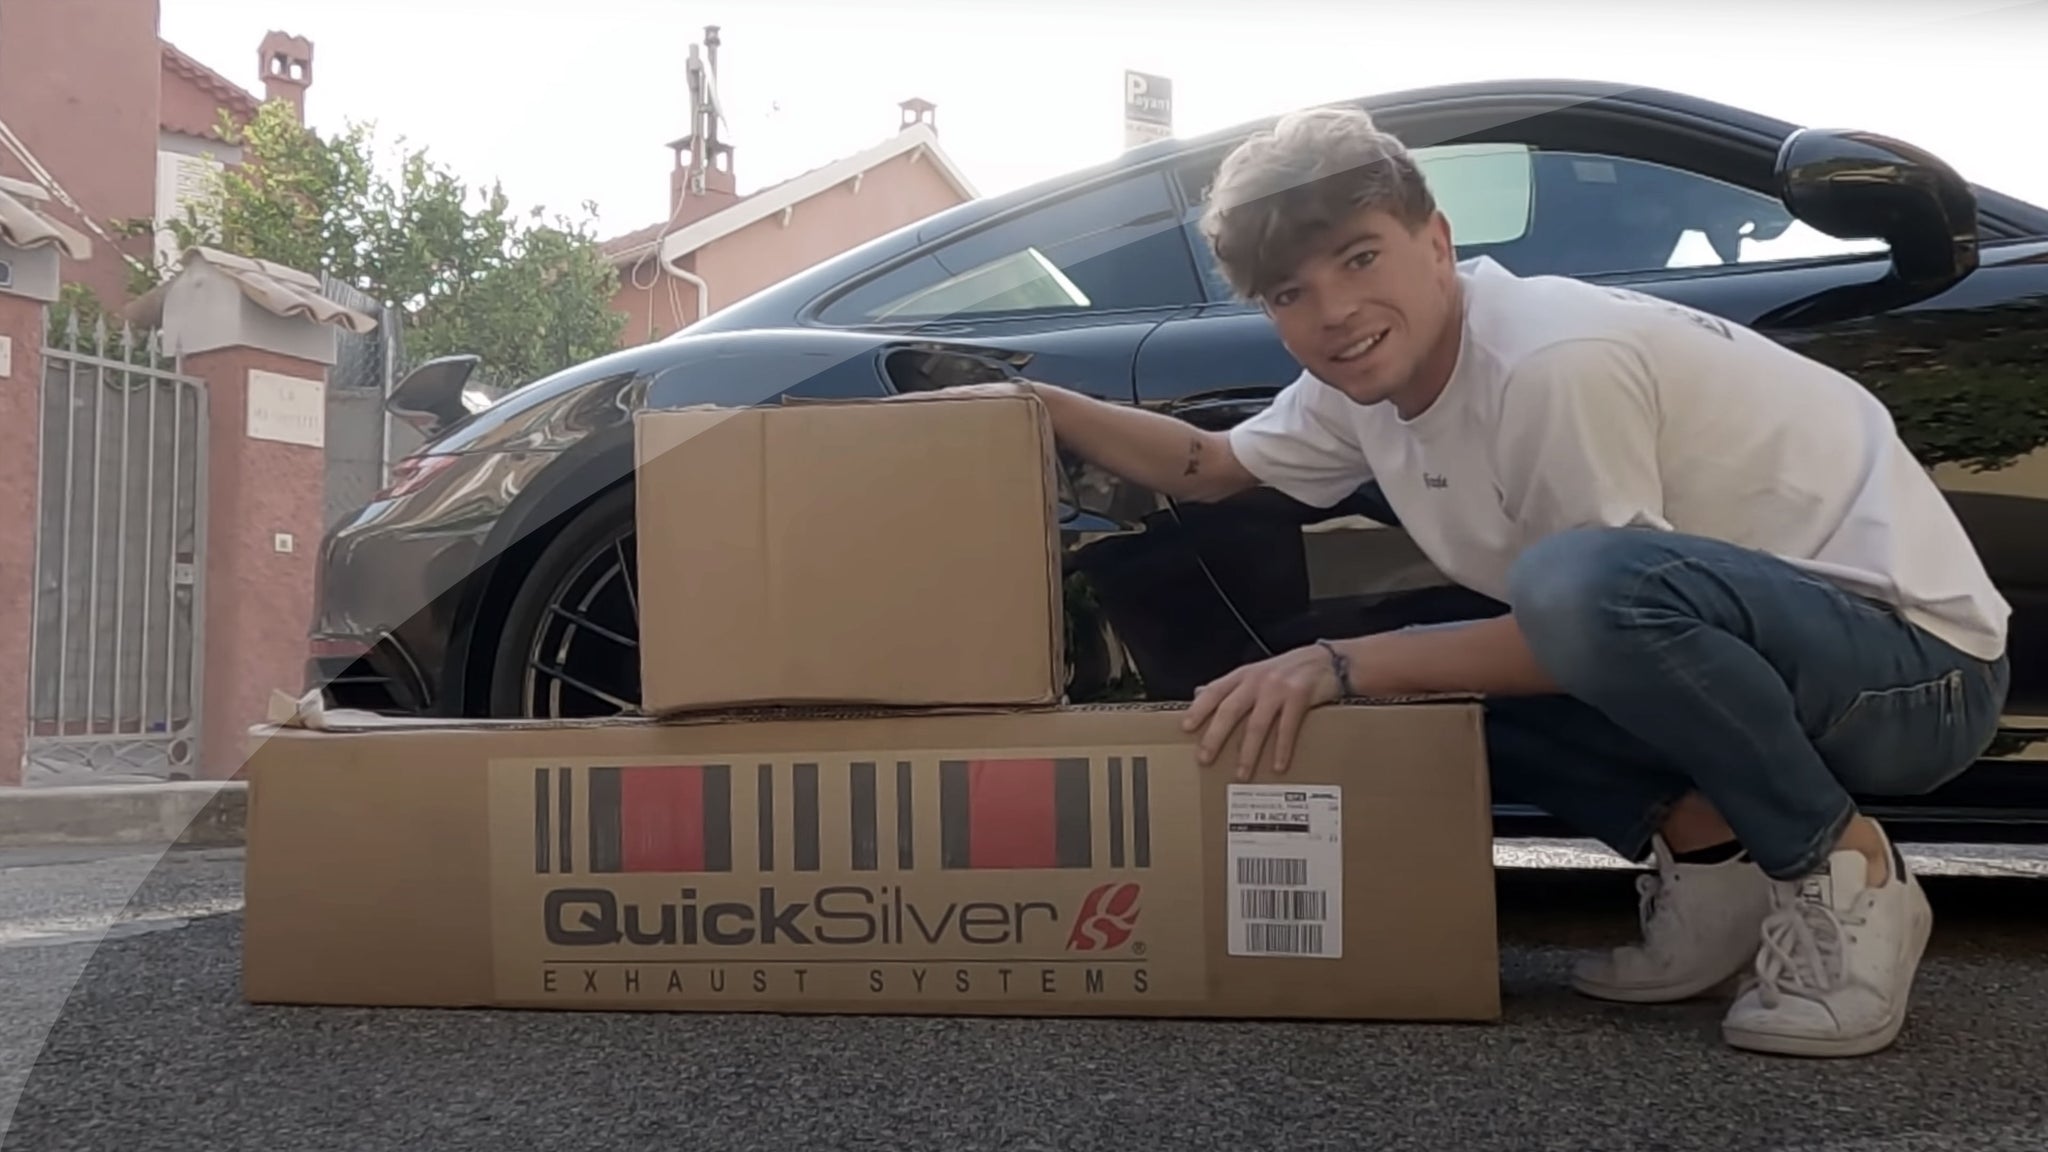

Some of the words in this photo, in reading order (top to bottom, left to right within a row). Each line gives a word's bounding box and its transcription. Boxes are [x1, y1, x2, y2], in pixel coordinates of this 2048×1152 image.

[1127, 74, 1170, 111] Payant
[544, 886, 1059, 946] QuickSilver
[543, 968, 808, 993] EXHAUST
[869, 968, 1149, 993] SYSTEMS
